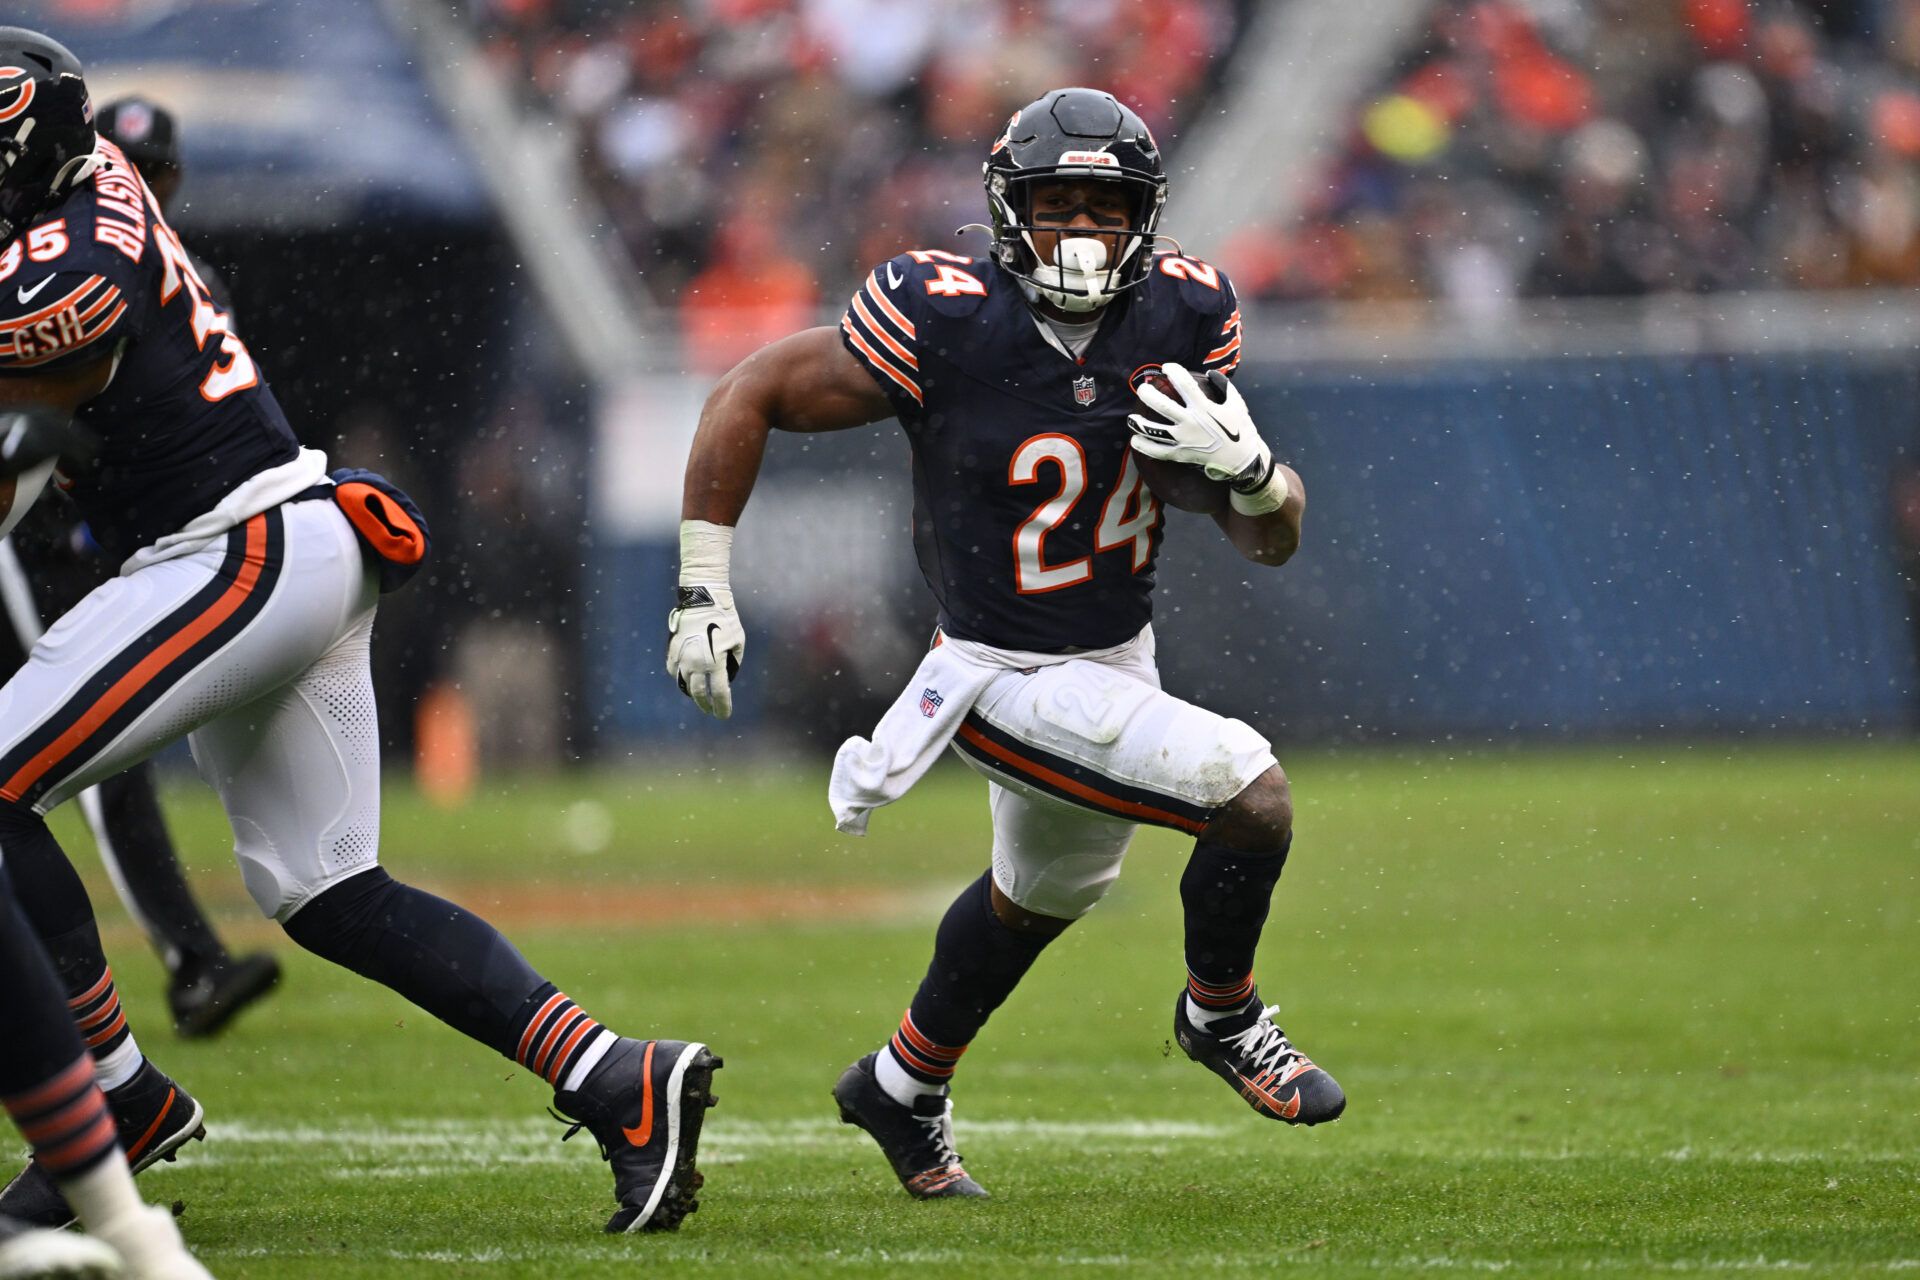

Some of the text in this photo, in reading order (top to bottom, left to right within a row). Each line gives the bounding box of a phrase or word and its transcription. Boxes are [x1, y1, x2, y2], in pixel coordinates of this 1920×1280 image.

[1152, 250, 1219, 291] 2
[13, 303, 85, 361] GSH
[1077, 388, 1093, 401] NFL
[1008, 432, 1159, 595] 24
